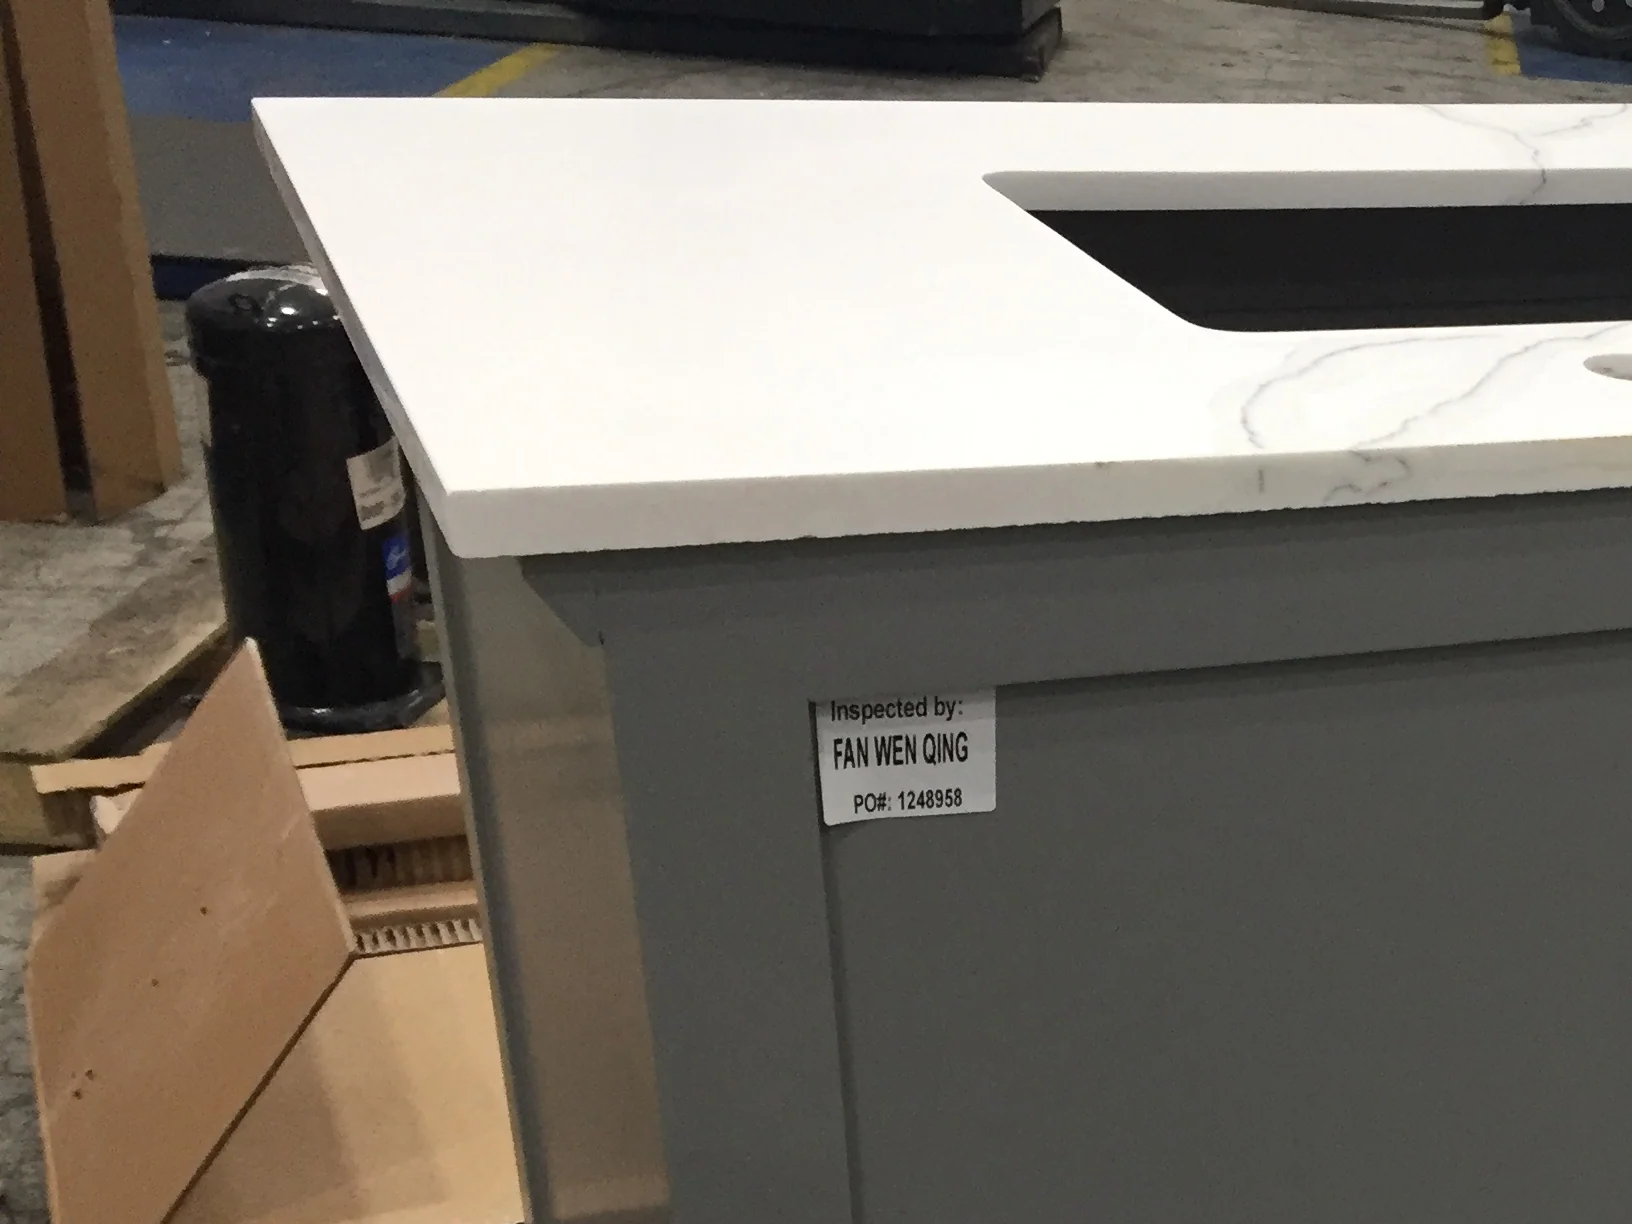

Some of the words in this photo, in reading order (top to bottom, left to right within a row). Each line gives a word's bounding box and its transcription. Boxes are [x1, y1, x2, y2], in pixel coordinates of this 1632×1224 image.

[831, 696, 928, 724] Inspected
[934, 696, 964, 721] by:
[833, 736, 869, 770] FAN
[874, 734, 917, 767] WEN
[923, 731, 969, 765] QING
[853, 792, 892, 814] PO#:
[897, 787, 963, 811] 1248958
